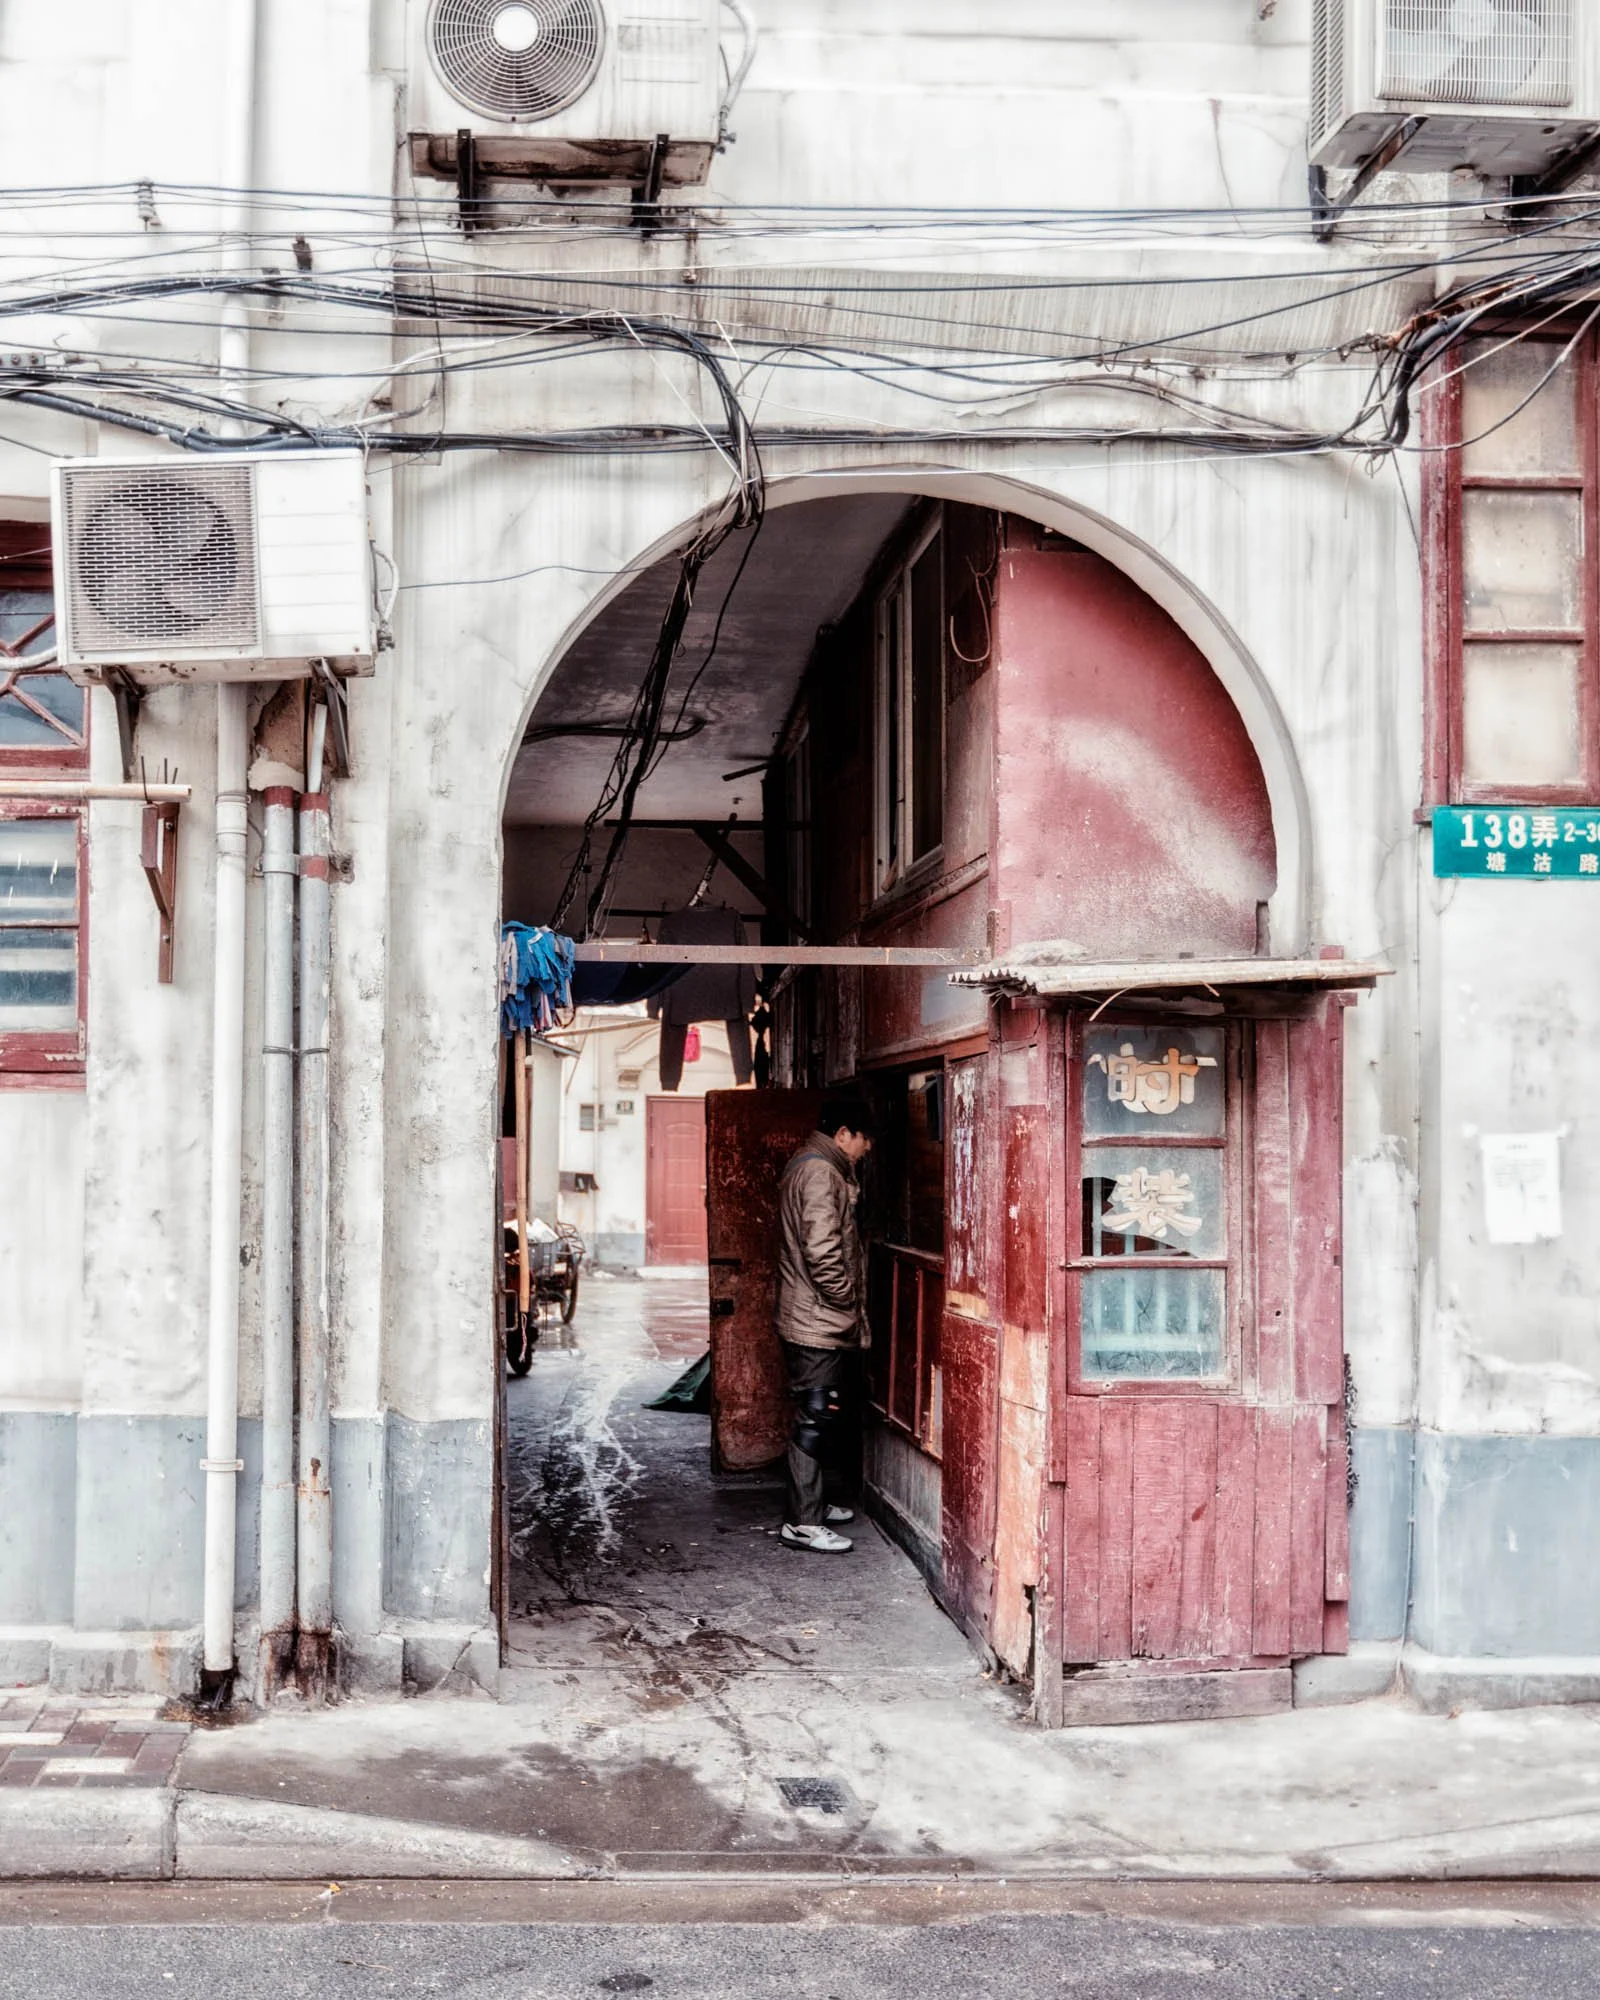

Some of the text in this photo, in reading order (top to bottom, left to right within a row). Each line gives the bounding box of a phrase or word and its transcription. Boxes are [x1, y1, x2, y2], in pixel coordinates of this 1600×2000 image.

[1563, 822, 1600, 843] 2-3
[1486, 852, 1599, 874] 塘沽路
